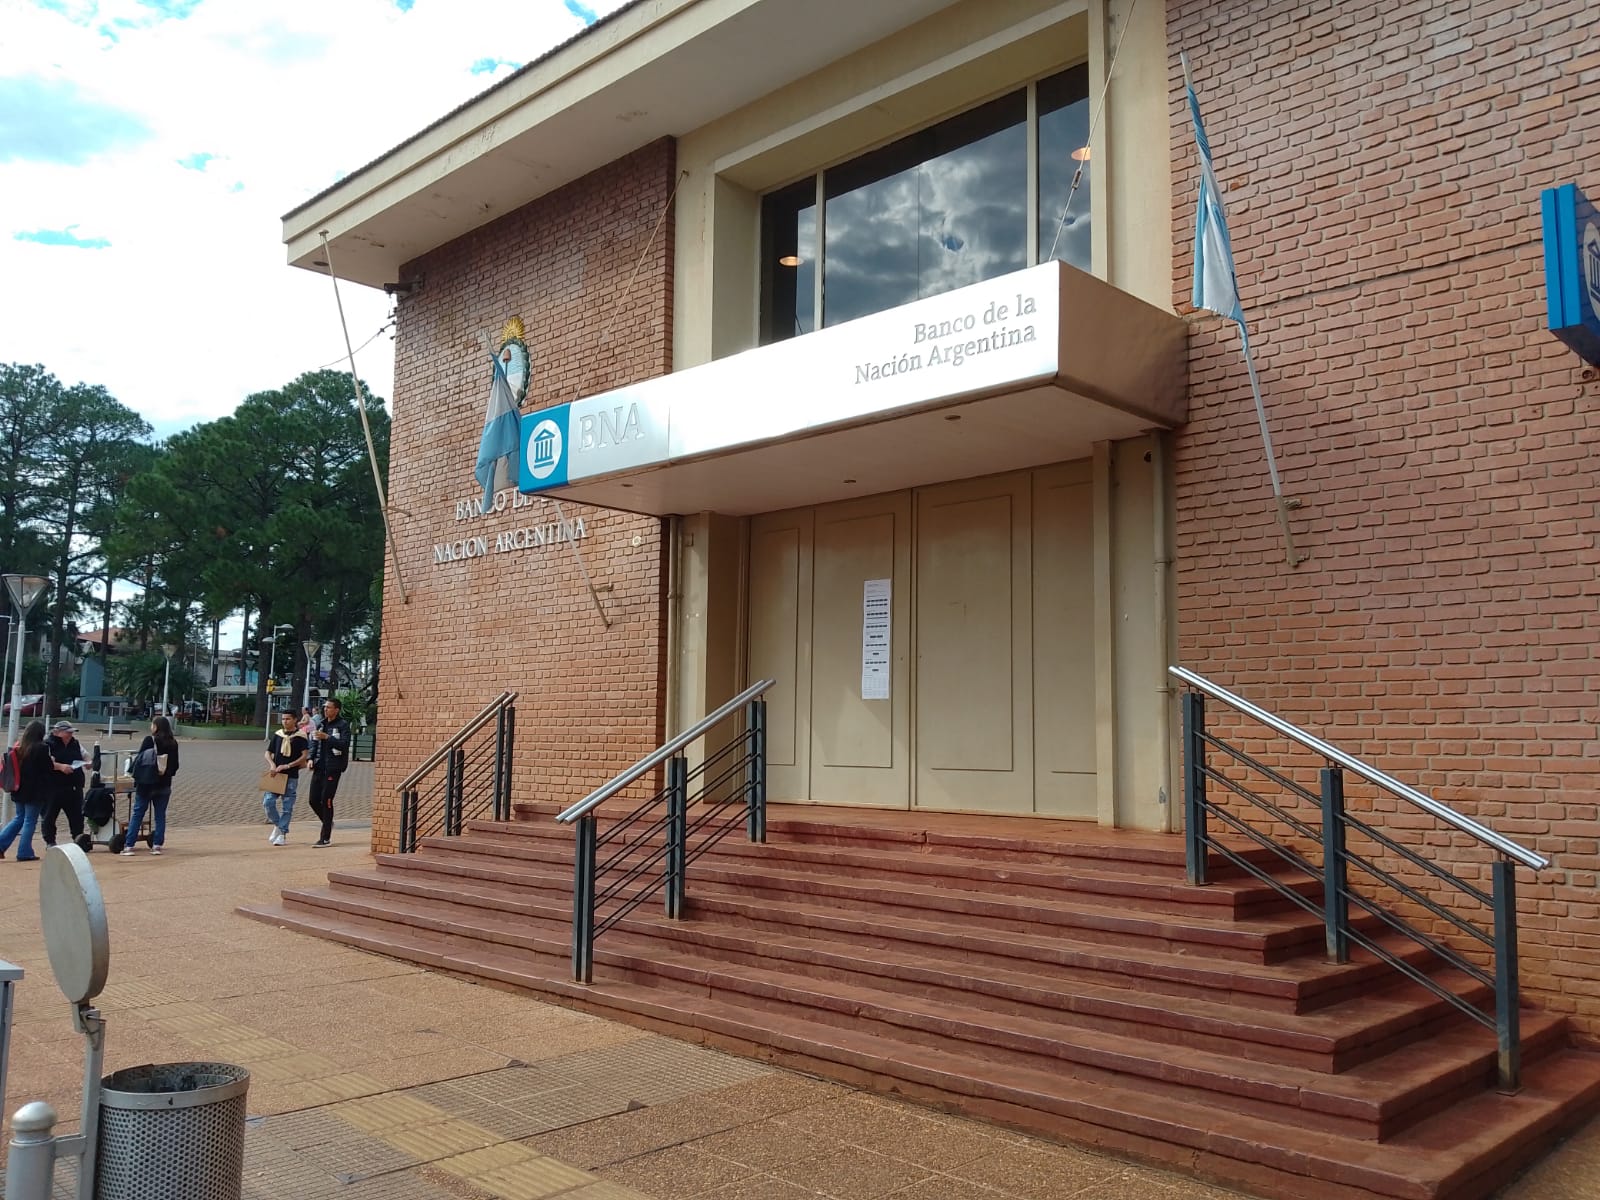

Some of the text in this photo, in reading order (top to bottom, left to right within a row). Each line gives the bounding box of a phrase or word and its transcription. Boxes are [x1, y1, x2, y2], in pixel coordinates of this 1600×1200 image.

[913, 293, 1037, 344] Banco de la
[854, 324, 1037, 385] Nación Argentina
[578, 402, 645, 453] BNA
[455, 490, 507, 521] BANO
[433, 517, 588, 565] NACION ARGENTINA
